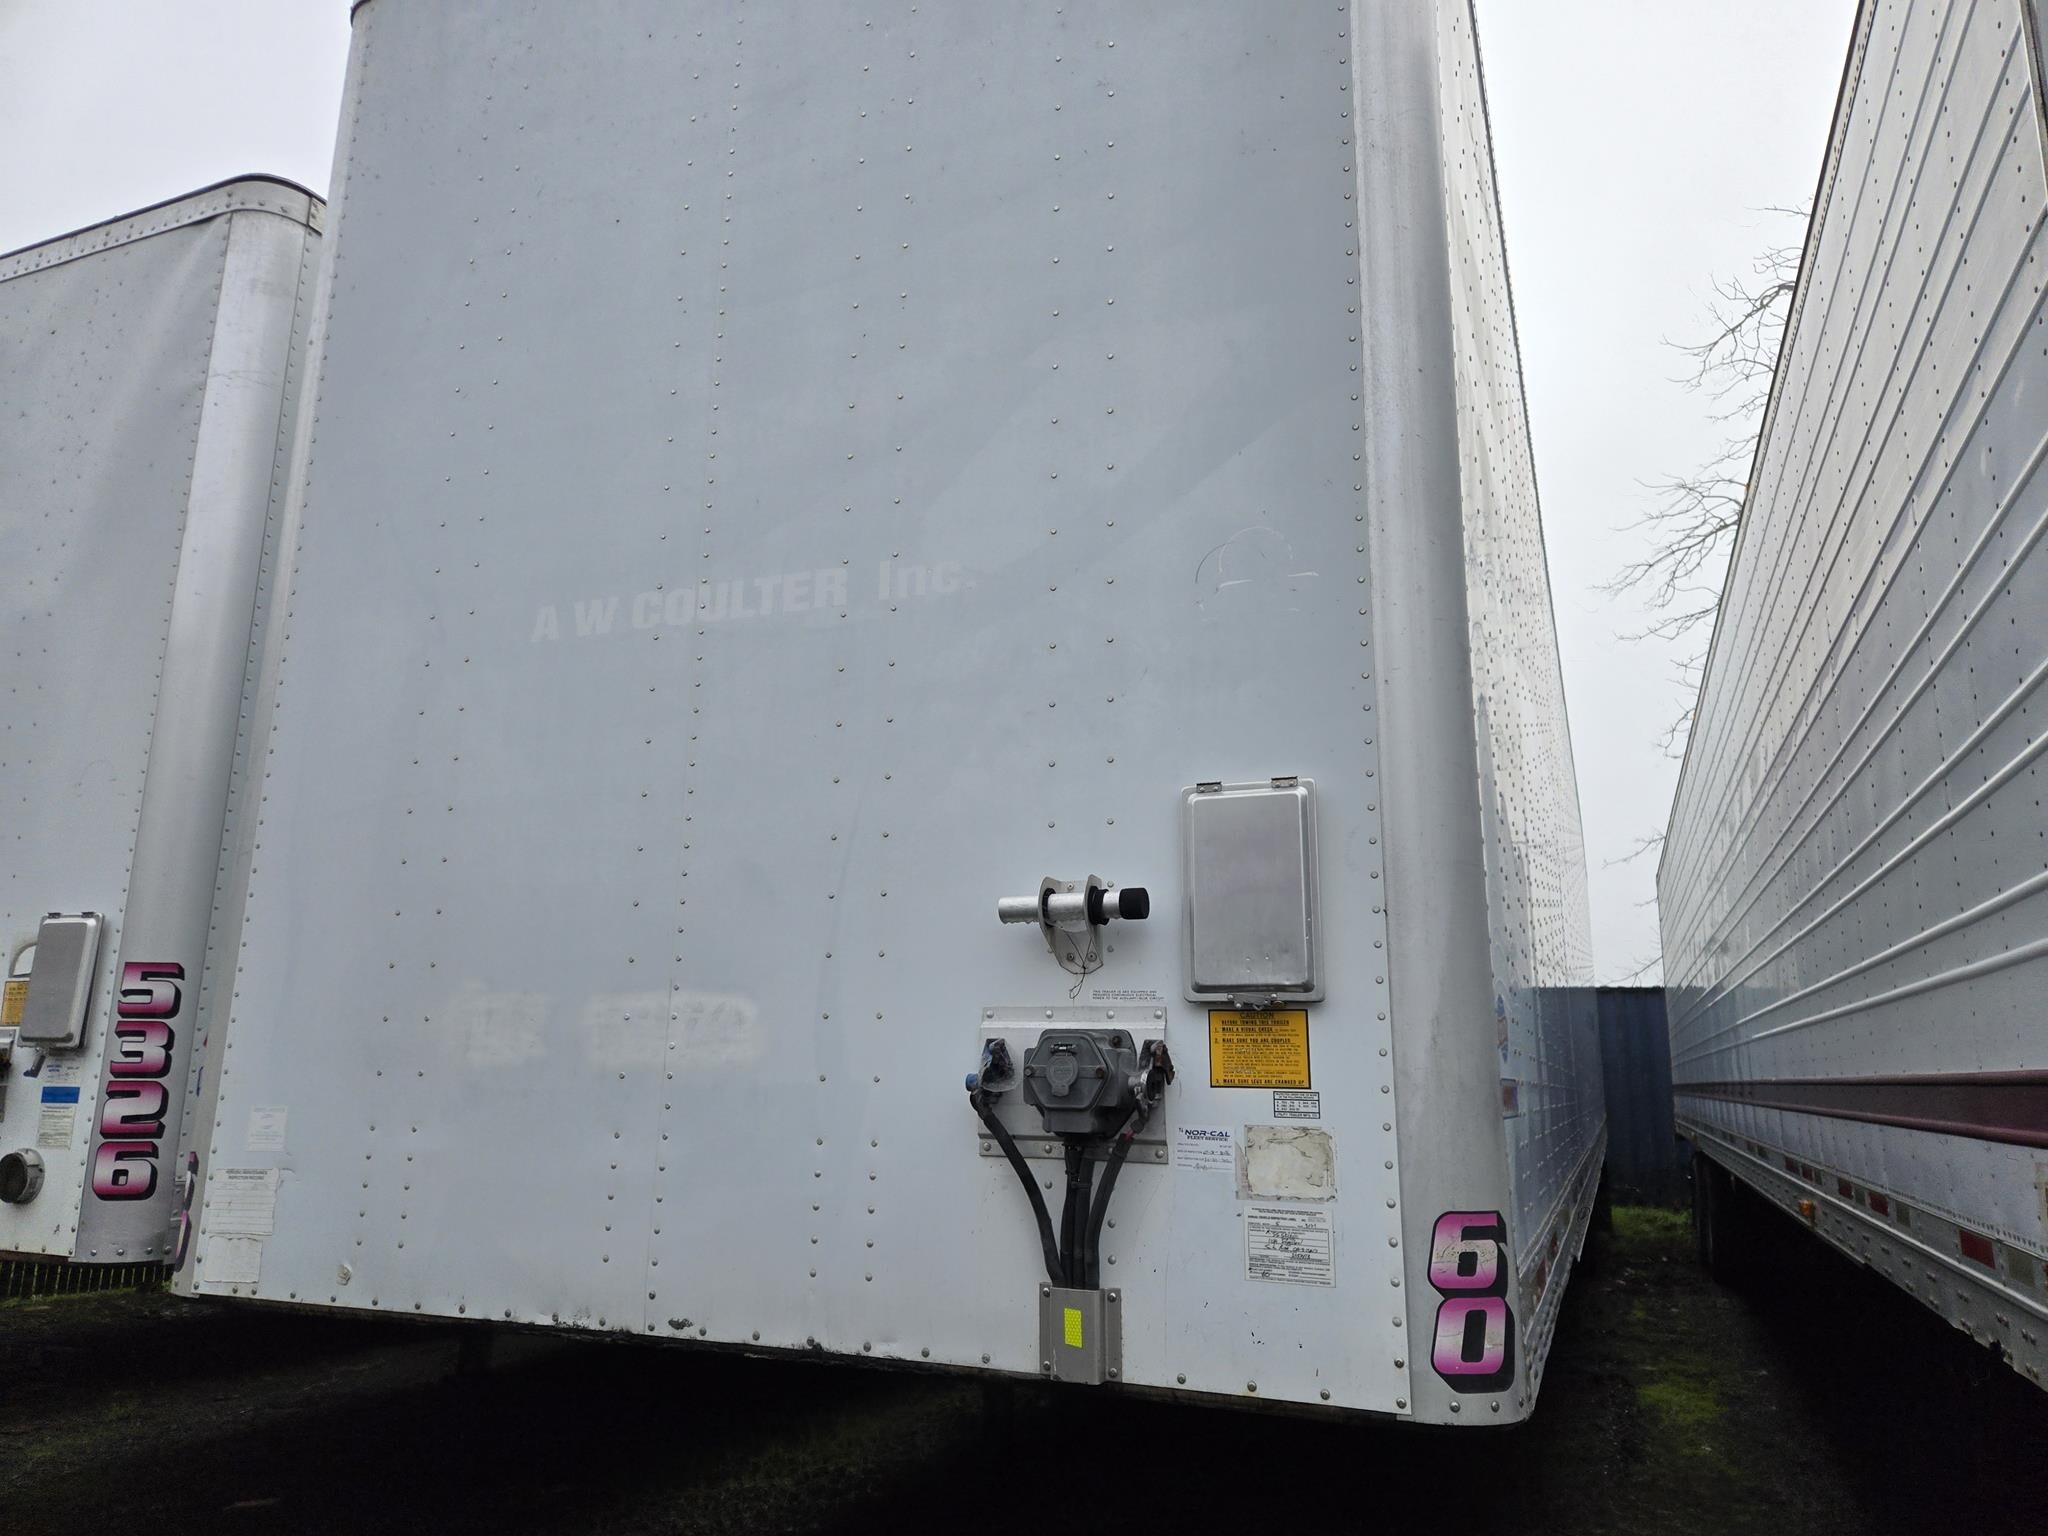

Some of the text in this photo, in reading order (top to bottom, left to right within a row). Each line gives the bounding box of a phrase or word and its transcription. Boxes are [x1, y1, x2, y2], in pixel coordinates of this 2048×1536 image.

[531, 601, 560, 642] A
[574, 596, 619, 637] W
[631, 567, 848, 630] COULTER
[92, 961, 185, 1201] 5326
[1184, 1129, 1231, 1138] NOR-CAL
[1427, 1210, 1516, 1394] 60
